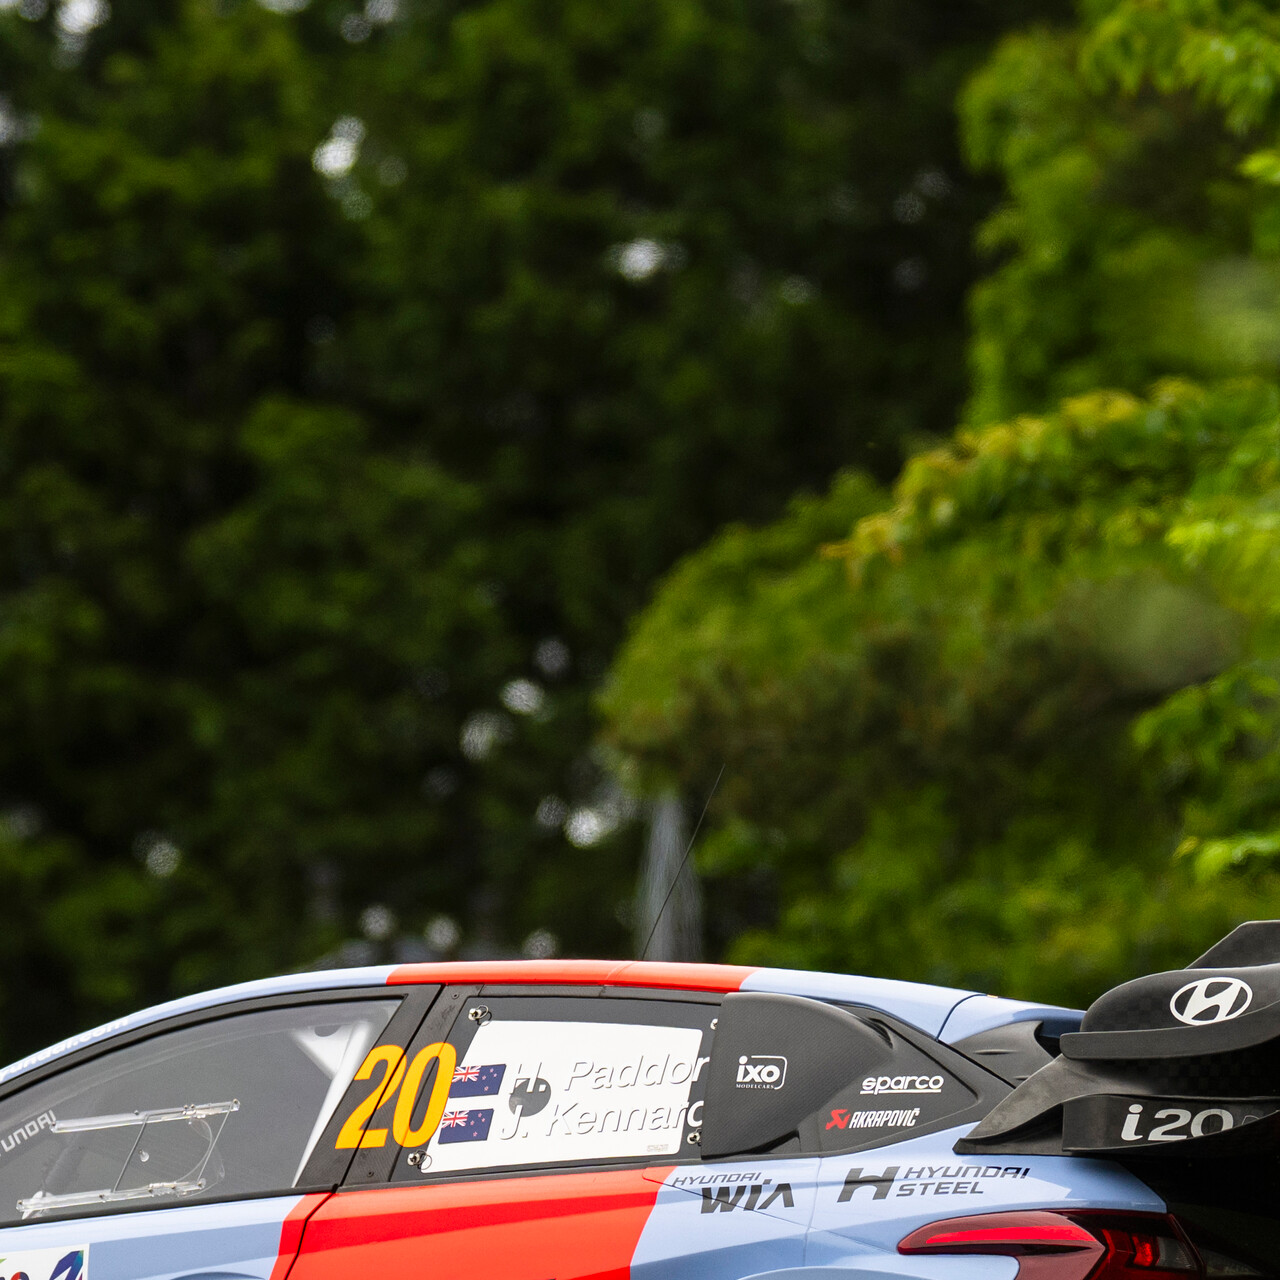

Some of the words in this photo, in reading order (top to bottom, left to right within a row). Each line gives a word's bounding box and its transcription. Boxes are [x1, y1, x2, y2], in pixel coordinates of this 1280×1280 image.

[861, 1075, 944, 1095] sparco
[335, 1042, 457, 1149] 20
[1121, 1104, 1234, 1141] i20
[672, 1172, 762, 1187] HYUNDAI
[904, 1166, 1030, 1180] HYUNDAI
[896, 1182, 984, 1198] STEEL
